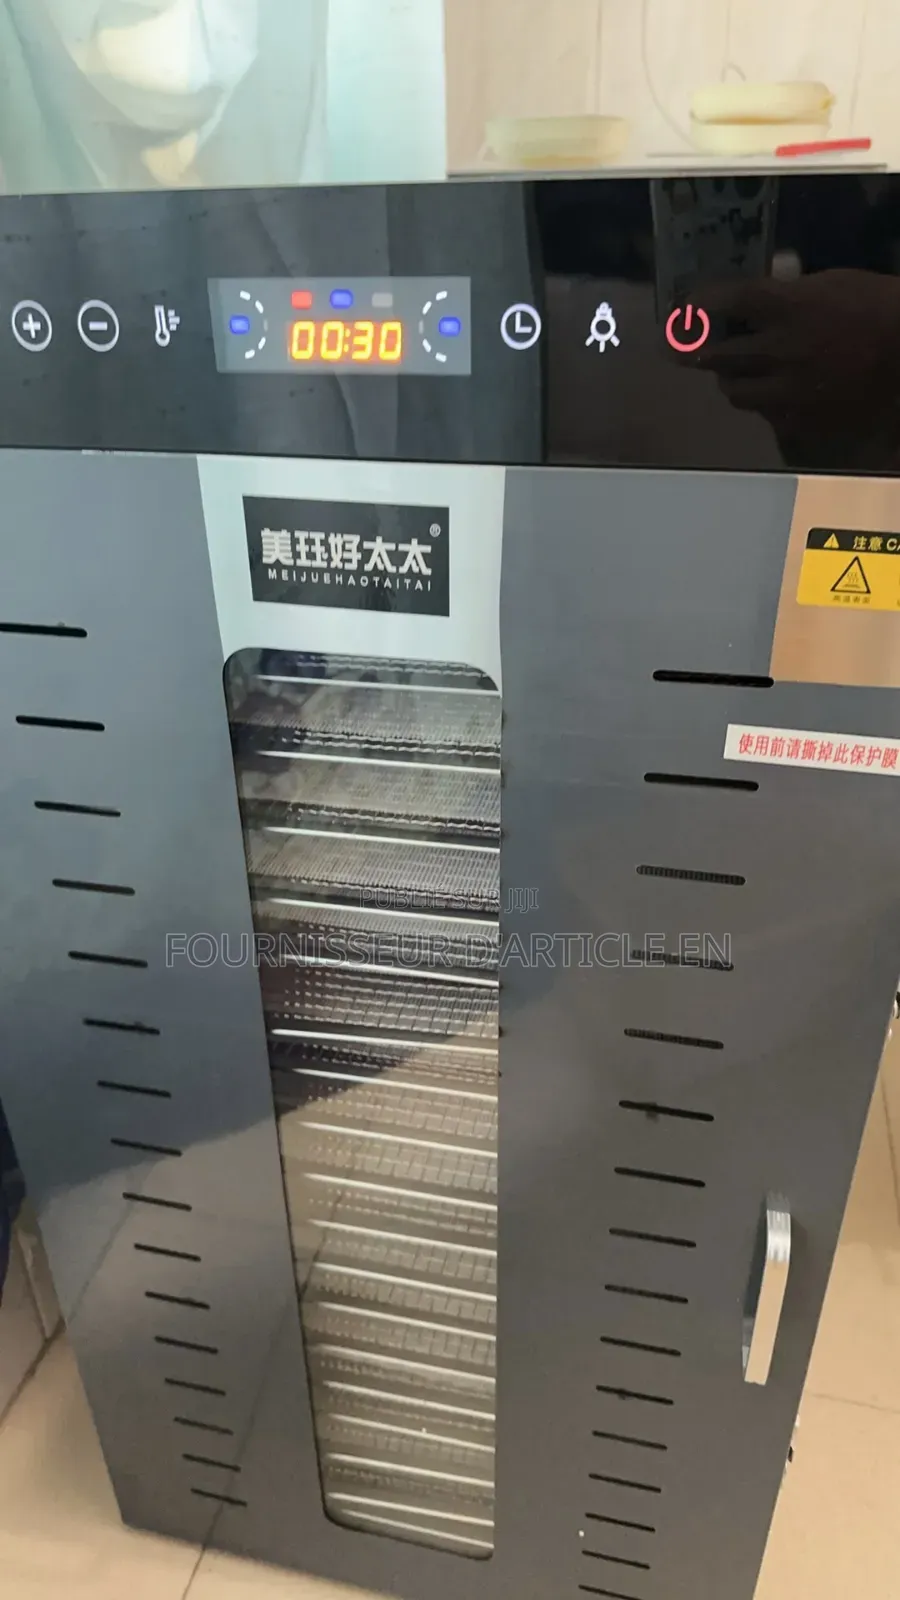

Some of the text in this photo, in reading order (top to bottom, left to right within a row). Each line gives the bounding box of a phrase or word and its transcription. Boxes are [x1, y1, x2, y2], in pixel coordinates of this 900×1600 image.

[291, 320, 402, 361] 00:30
[852, 535, 882, 551] 注意
[267, 568, 432, 592] MEIJUEHAOTAITAI
[738, 733, 899, 769] 使用前请撕掉此保护膜
